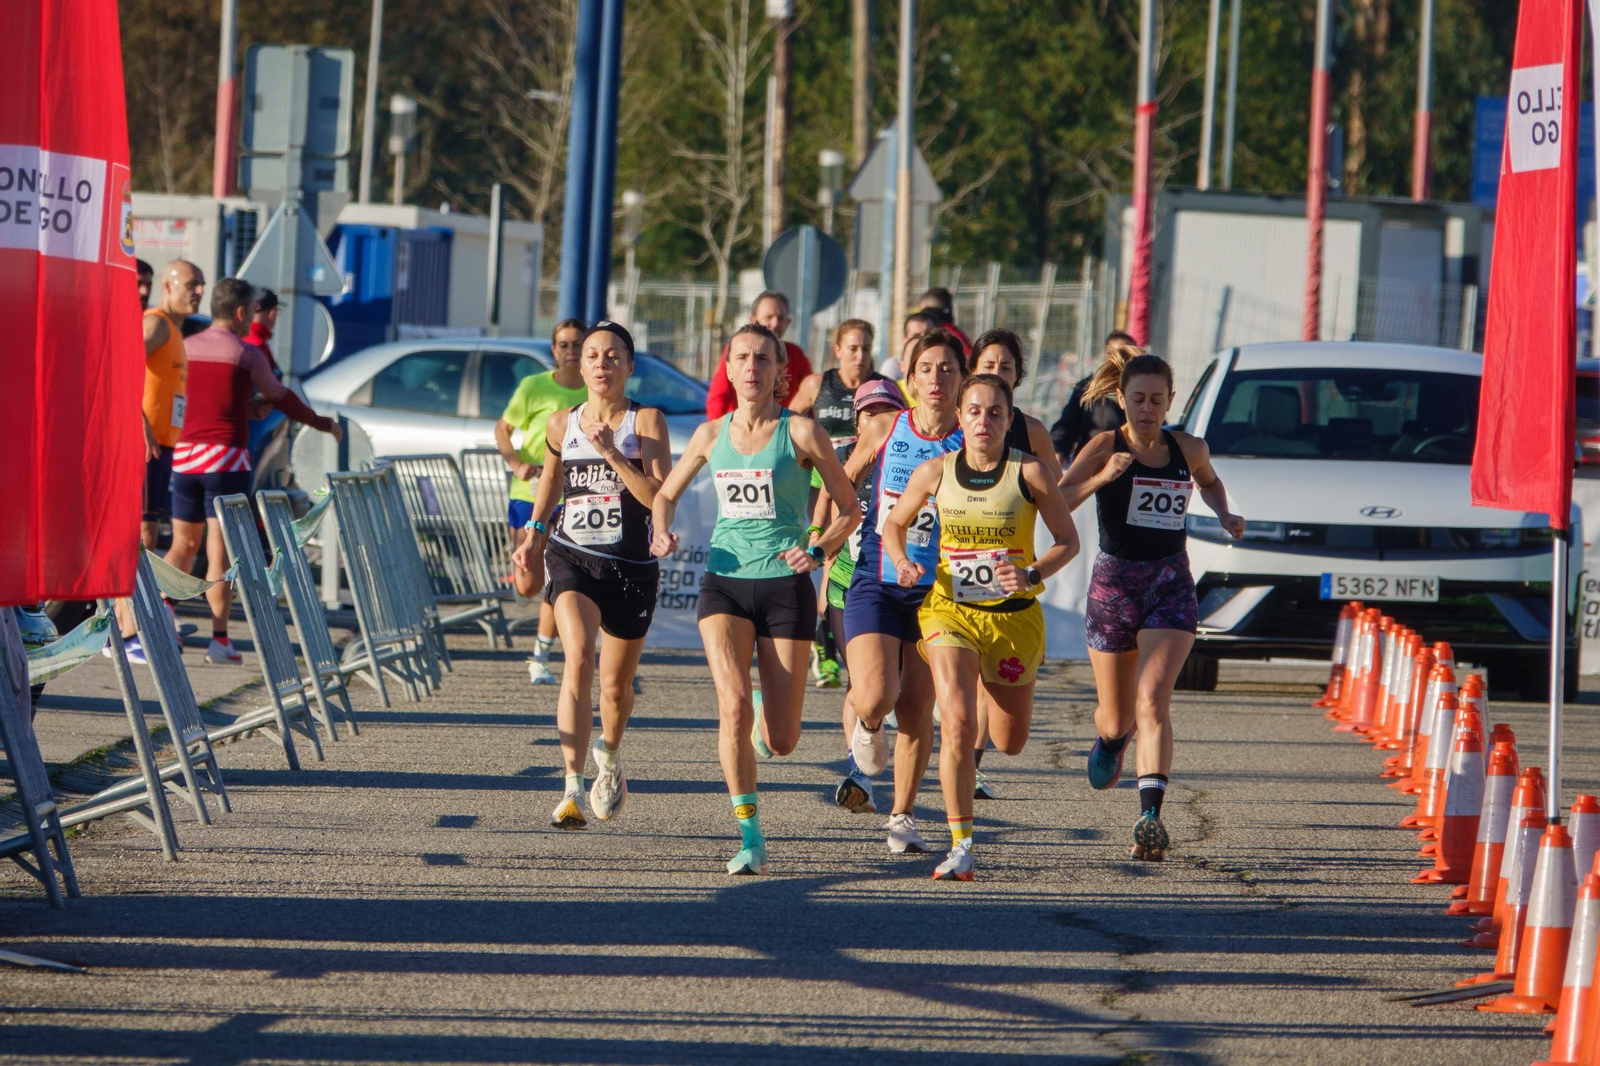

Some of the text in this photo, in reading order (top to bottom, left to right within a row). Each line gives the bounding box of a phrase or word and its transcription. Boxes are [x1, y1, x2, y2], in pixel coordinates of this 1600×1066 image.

[893, 475, 903, 483] DE
[726, 483, 771, 504] 201
[1137, 491, 1187, 516] 203
[571, 507, 622, 530] 205
[945, 524, 1016, 537] ATHLETICS
[954, 534, 1004, 545] San Lázaro
[959, 565, 993, 587] 20
[1337, 577, 1435, 597] 5362 NFN
